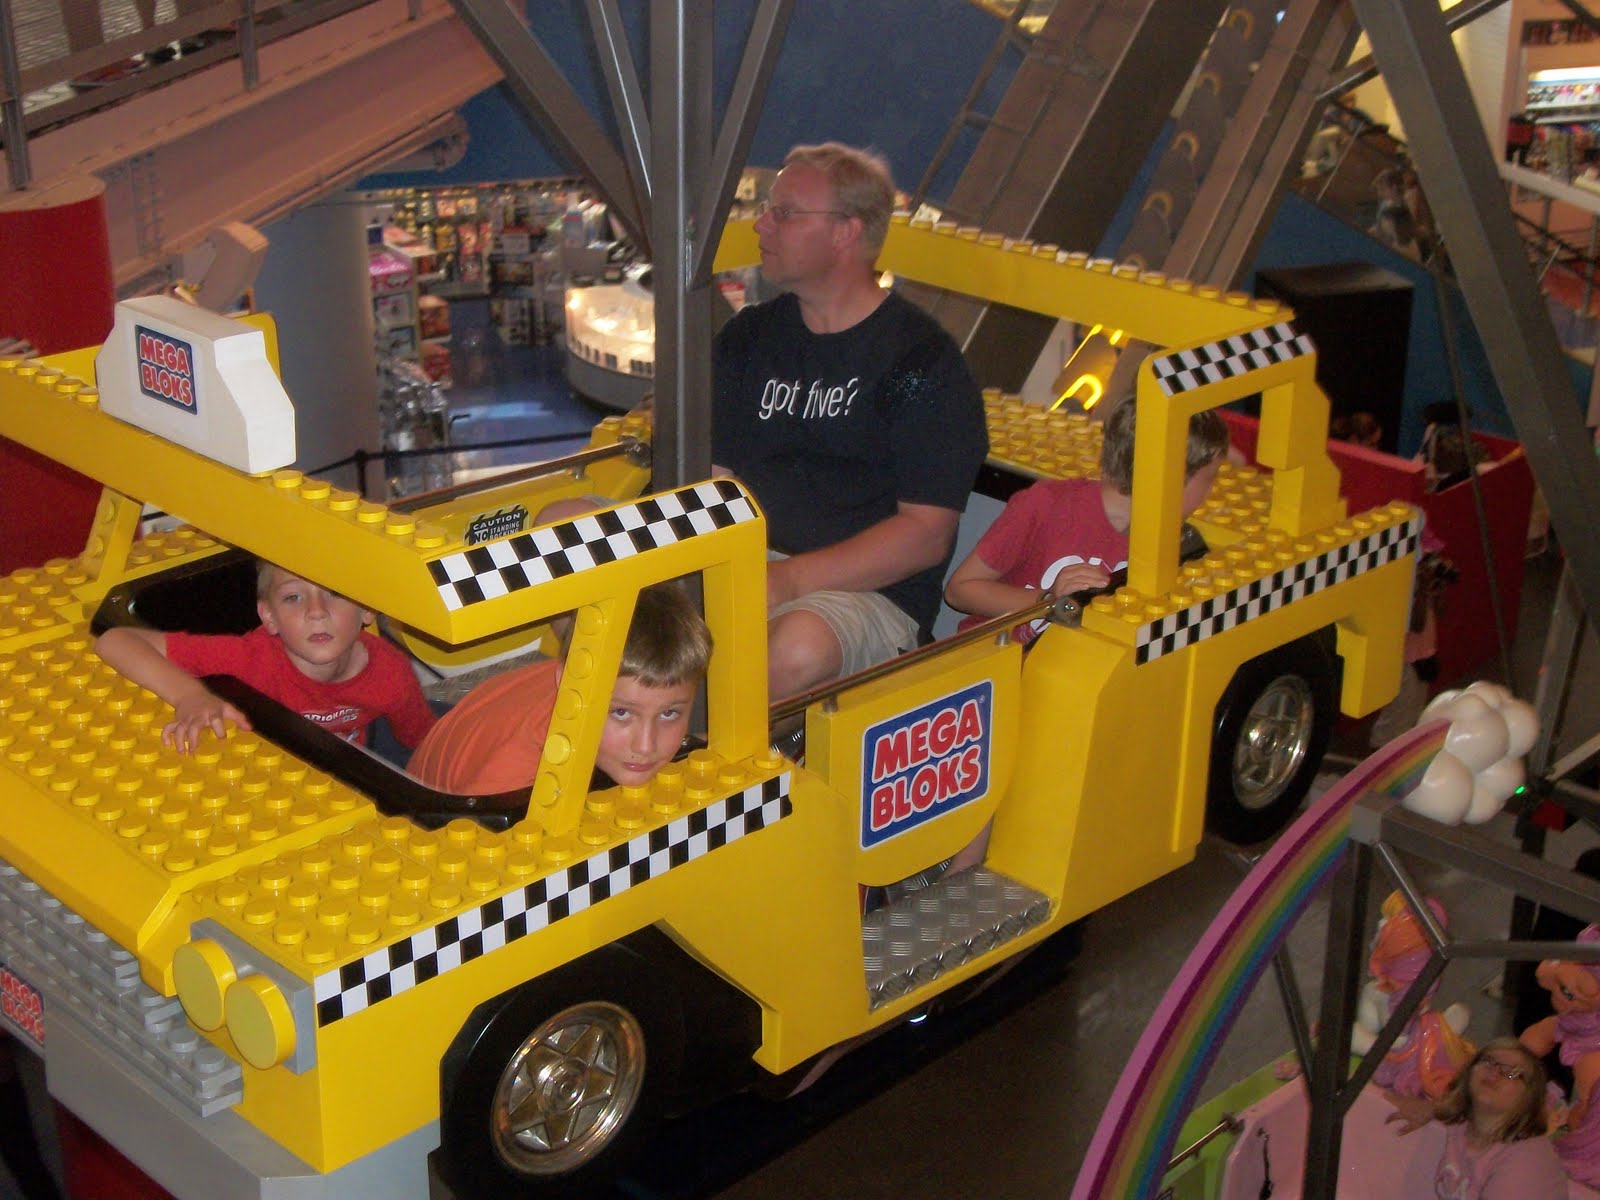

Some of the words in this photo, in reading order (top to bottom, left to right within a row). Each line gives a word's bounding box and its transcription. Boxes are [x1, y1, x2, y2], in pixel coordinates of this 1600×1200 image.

[139, 333, 191, 377] MEGA
[141, 361, 193, 407] BLOKS
[758, 378, 800, 420] got
[802, 378, 858, 419] five?
[473, 512, 521, 530] CAUTION
[473, 528, 489, 544] NO
[490, 520, 520, 535] STANDING
[871, 699, 983, 784] MEGA
[870, 744, 982, 832] BLOKS
